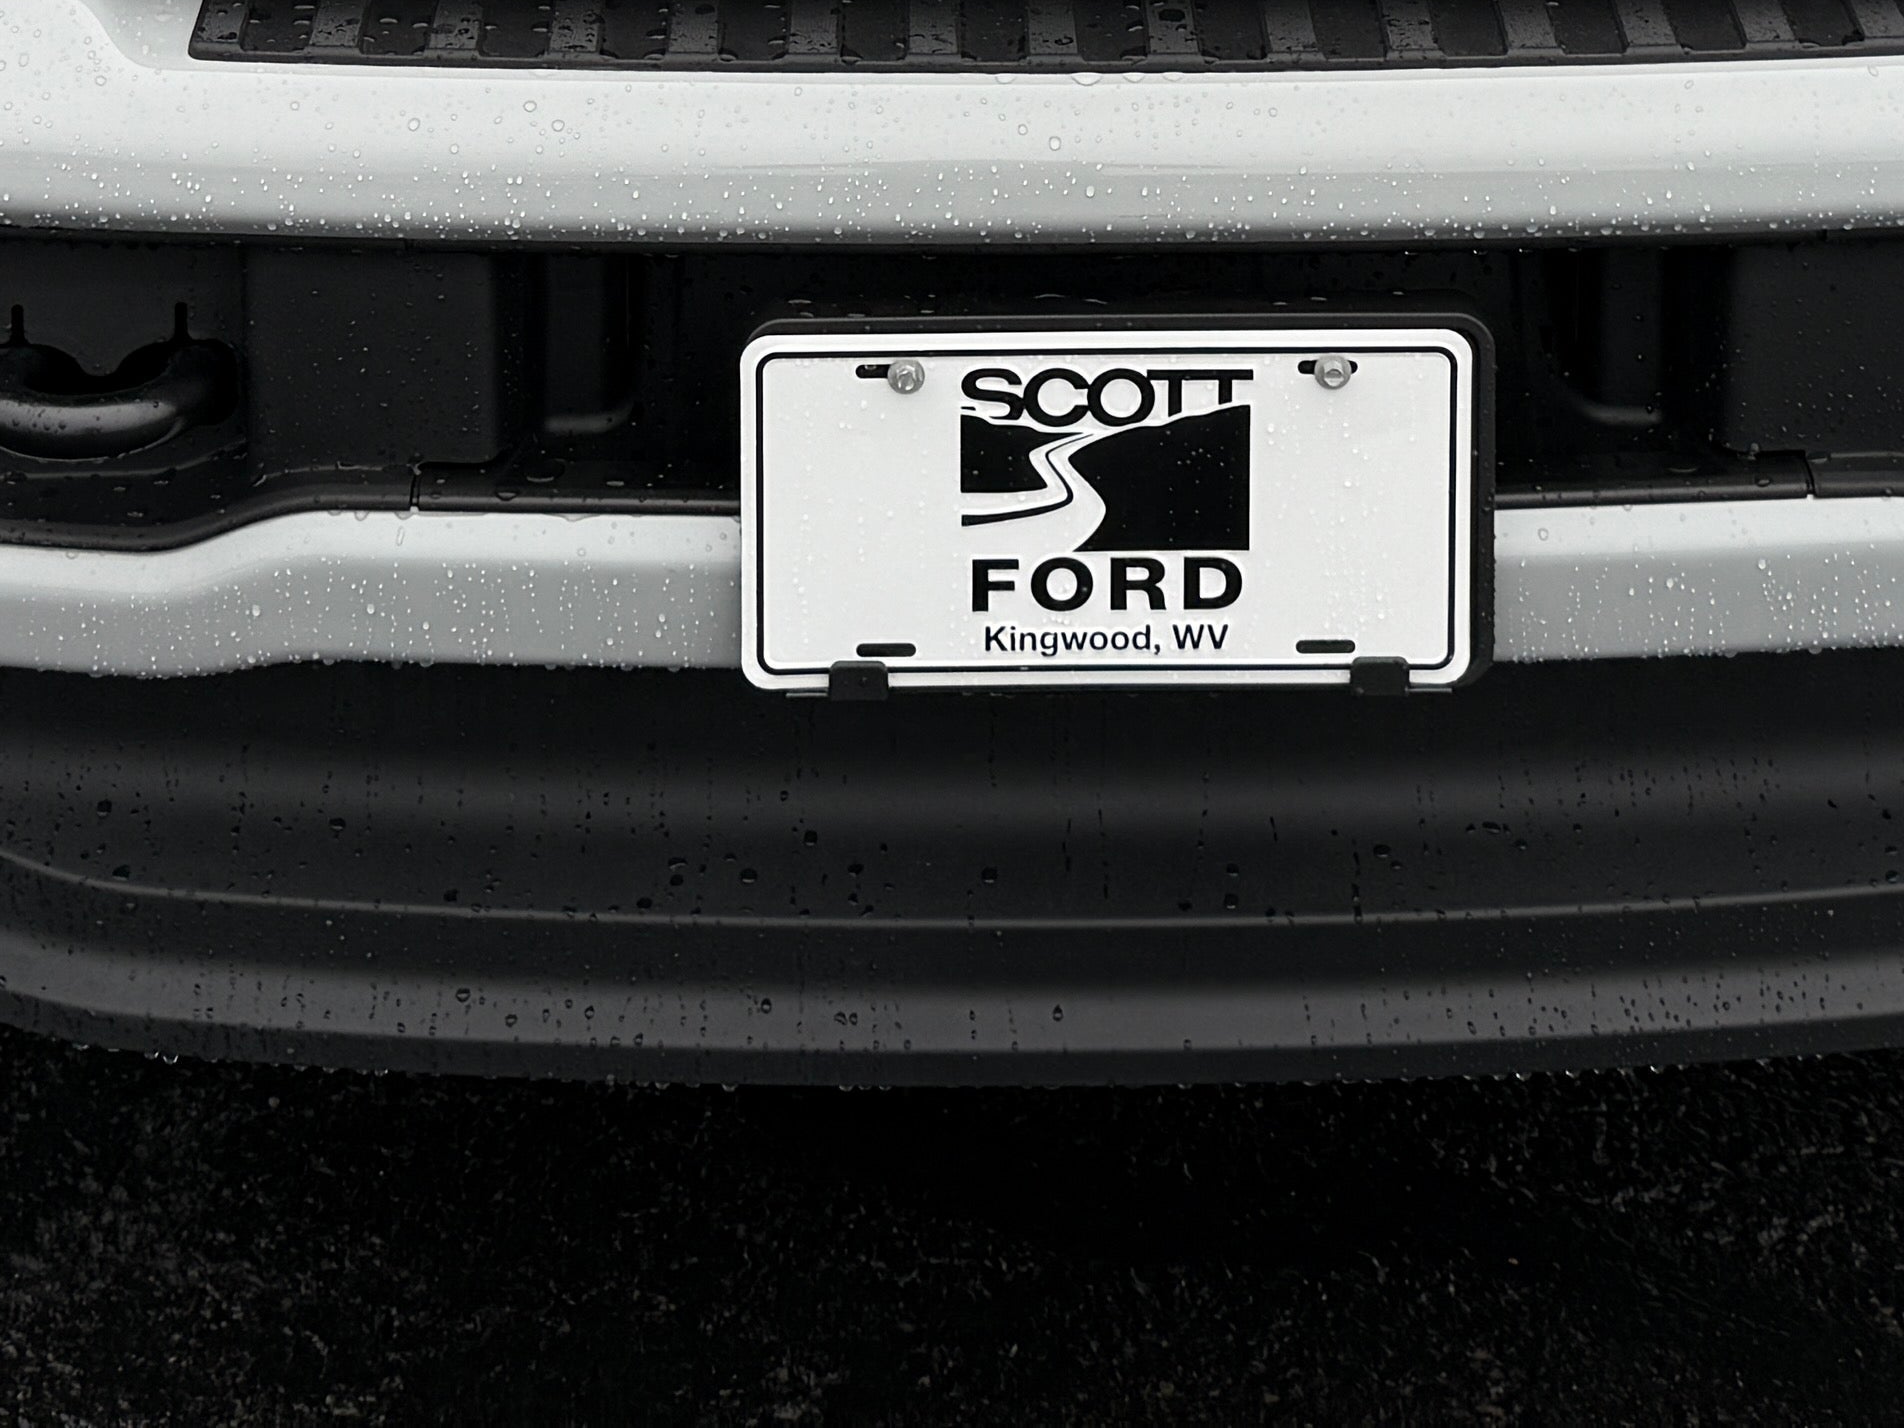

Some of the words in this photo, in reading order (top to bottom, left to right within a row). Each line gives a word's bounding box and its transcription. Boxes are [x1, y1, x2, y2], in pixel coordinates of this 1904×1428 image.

[960, 368, 1254, 428] SCOTT
[971, 556, 1243, 612] FORD
[984, 624, 1161, 657] Kingwood,
[1174, 624, 1229, 651] WV
